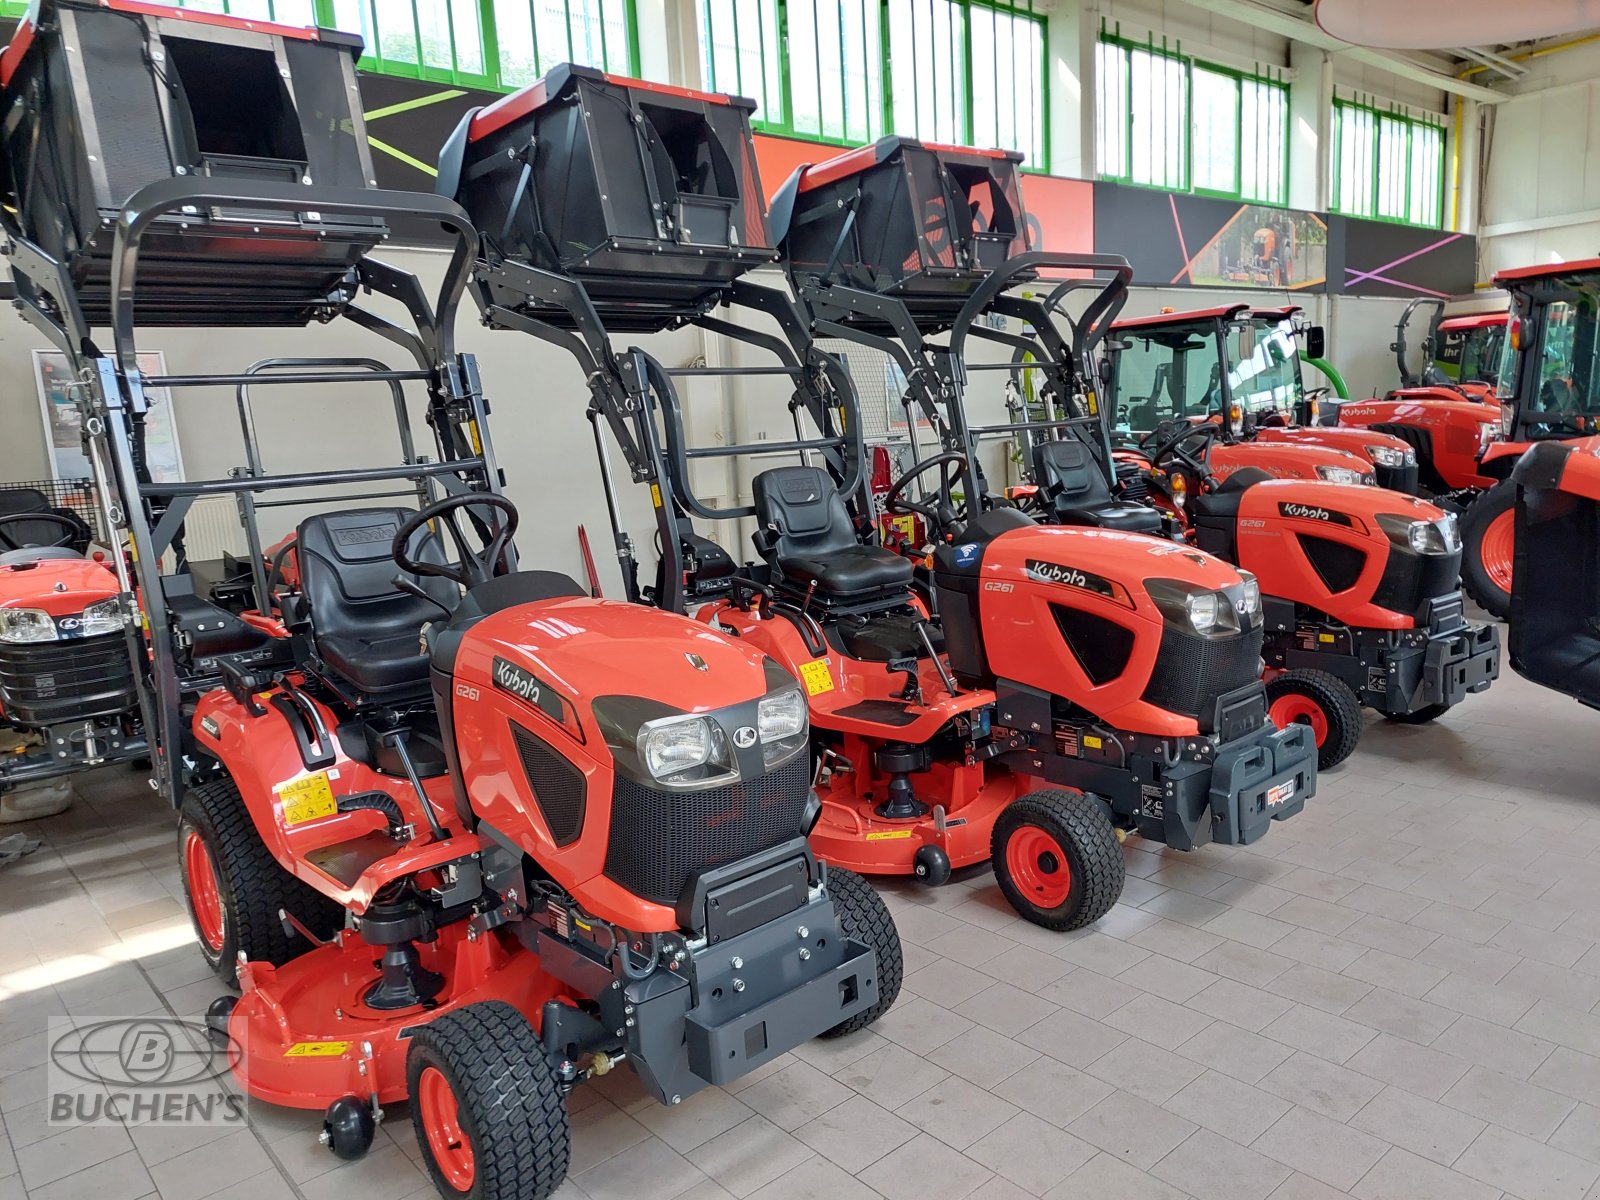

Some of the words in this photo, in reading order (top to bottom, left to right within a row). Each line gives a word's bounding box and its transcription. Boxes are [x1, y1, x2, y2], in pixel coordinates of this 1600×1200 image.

[1340, 406, 1377, 417] Kubota
[1284, 503, 1330, 521] Kubota
[1033, 561, 1086, 587] Kubota
[984, 581, 1015, 593] G261
[497, 661, 541, 704] Kubota
[455, 684, 481, 702] G261
